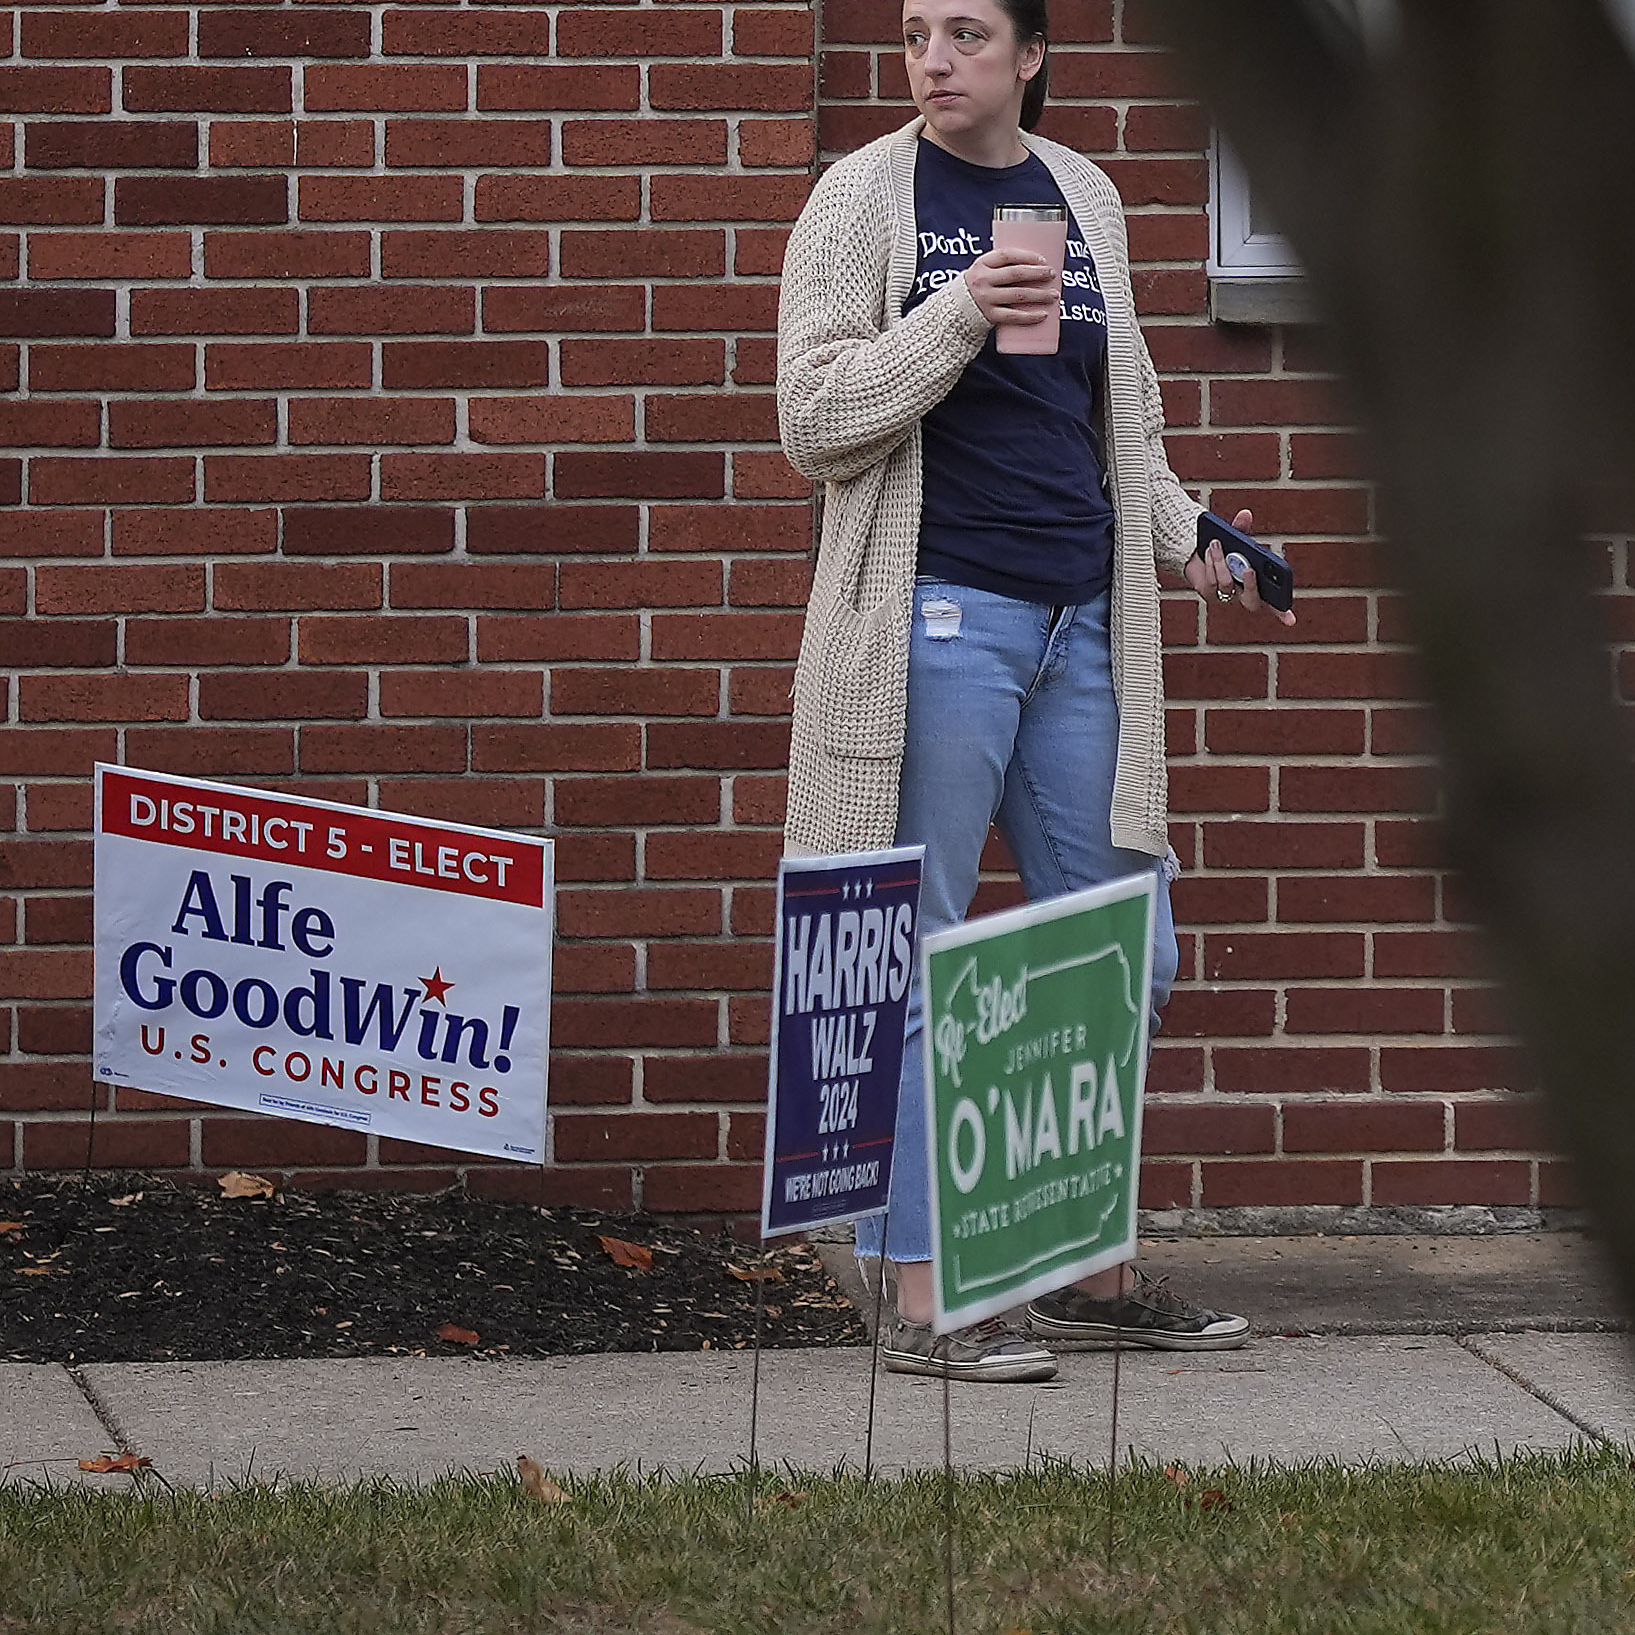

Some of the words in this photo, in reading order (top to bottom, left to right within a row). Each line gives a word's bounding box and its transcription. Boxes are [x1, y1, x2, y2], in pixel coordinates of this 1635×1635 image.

[918, 227, 983, 258] Don't
[130, 794, 313, 853] DISTRICT
[327, 830, 348, 859] 5
[389, 838, 514, 887] ELECT
[171, 870, 335, 958] Alfe
[785, 903, 912, 1016] HARRIS
[120, 942, 520, 1074] GoodWin!
[812, 1011, 877, 1081] WALZ
[140, 1025, 228, 1068] U.S.
[253, 1046, 501, 1118] CONGRESS
[818, 1079, 860, 1134] 2024
[948, 1052, 1126, 1194] O'MARA
[811, 1170, 830, 1198] NOT
